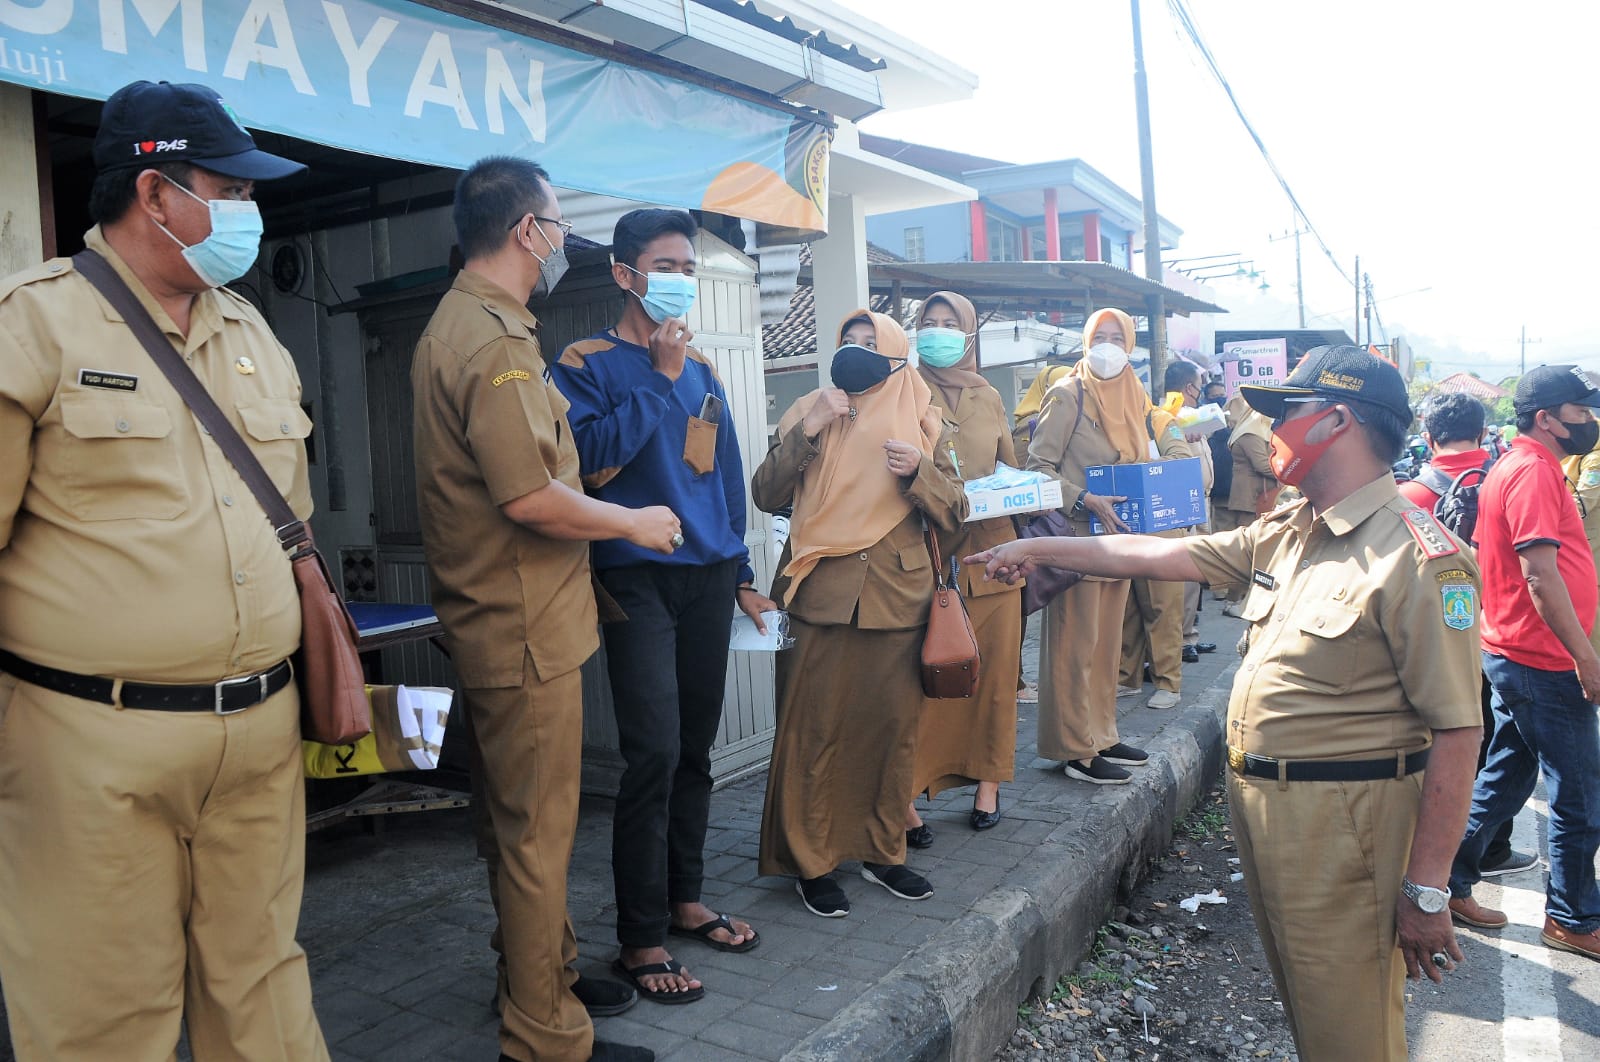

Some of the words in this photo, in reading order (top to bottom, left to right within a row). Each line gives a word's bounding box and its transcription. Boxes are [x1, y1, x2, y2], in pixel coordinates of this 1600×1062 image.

[134, 142, 142, 156] I
[155, 138, 188, 153] PAS
[811, 144, 828, 183] BAKSO
[1242, 347, 1279, 355] smartfren
[1238, 359, 1253, 377] 6
[1258, 367, 1273, 376] GB
[1189, 488, 1199, 497] F4
[975, 503, 988, 513] F4
